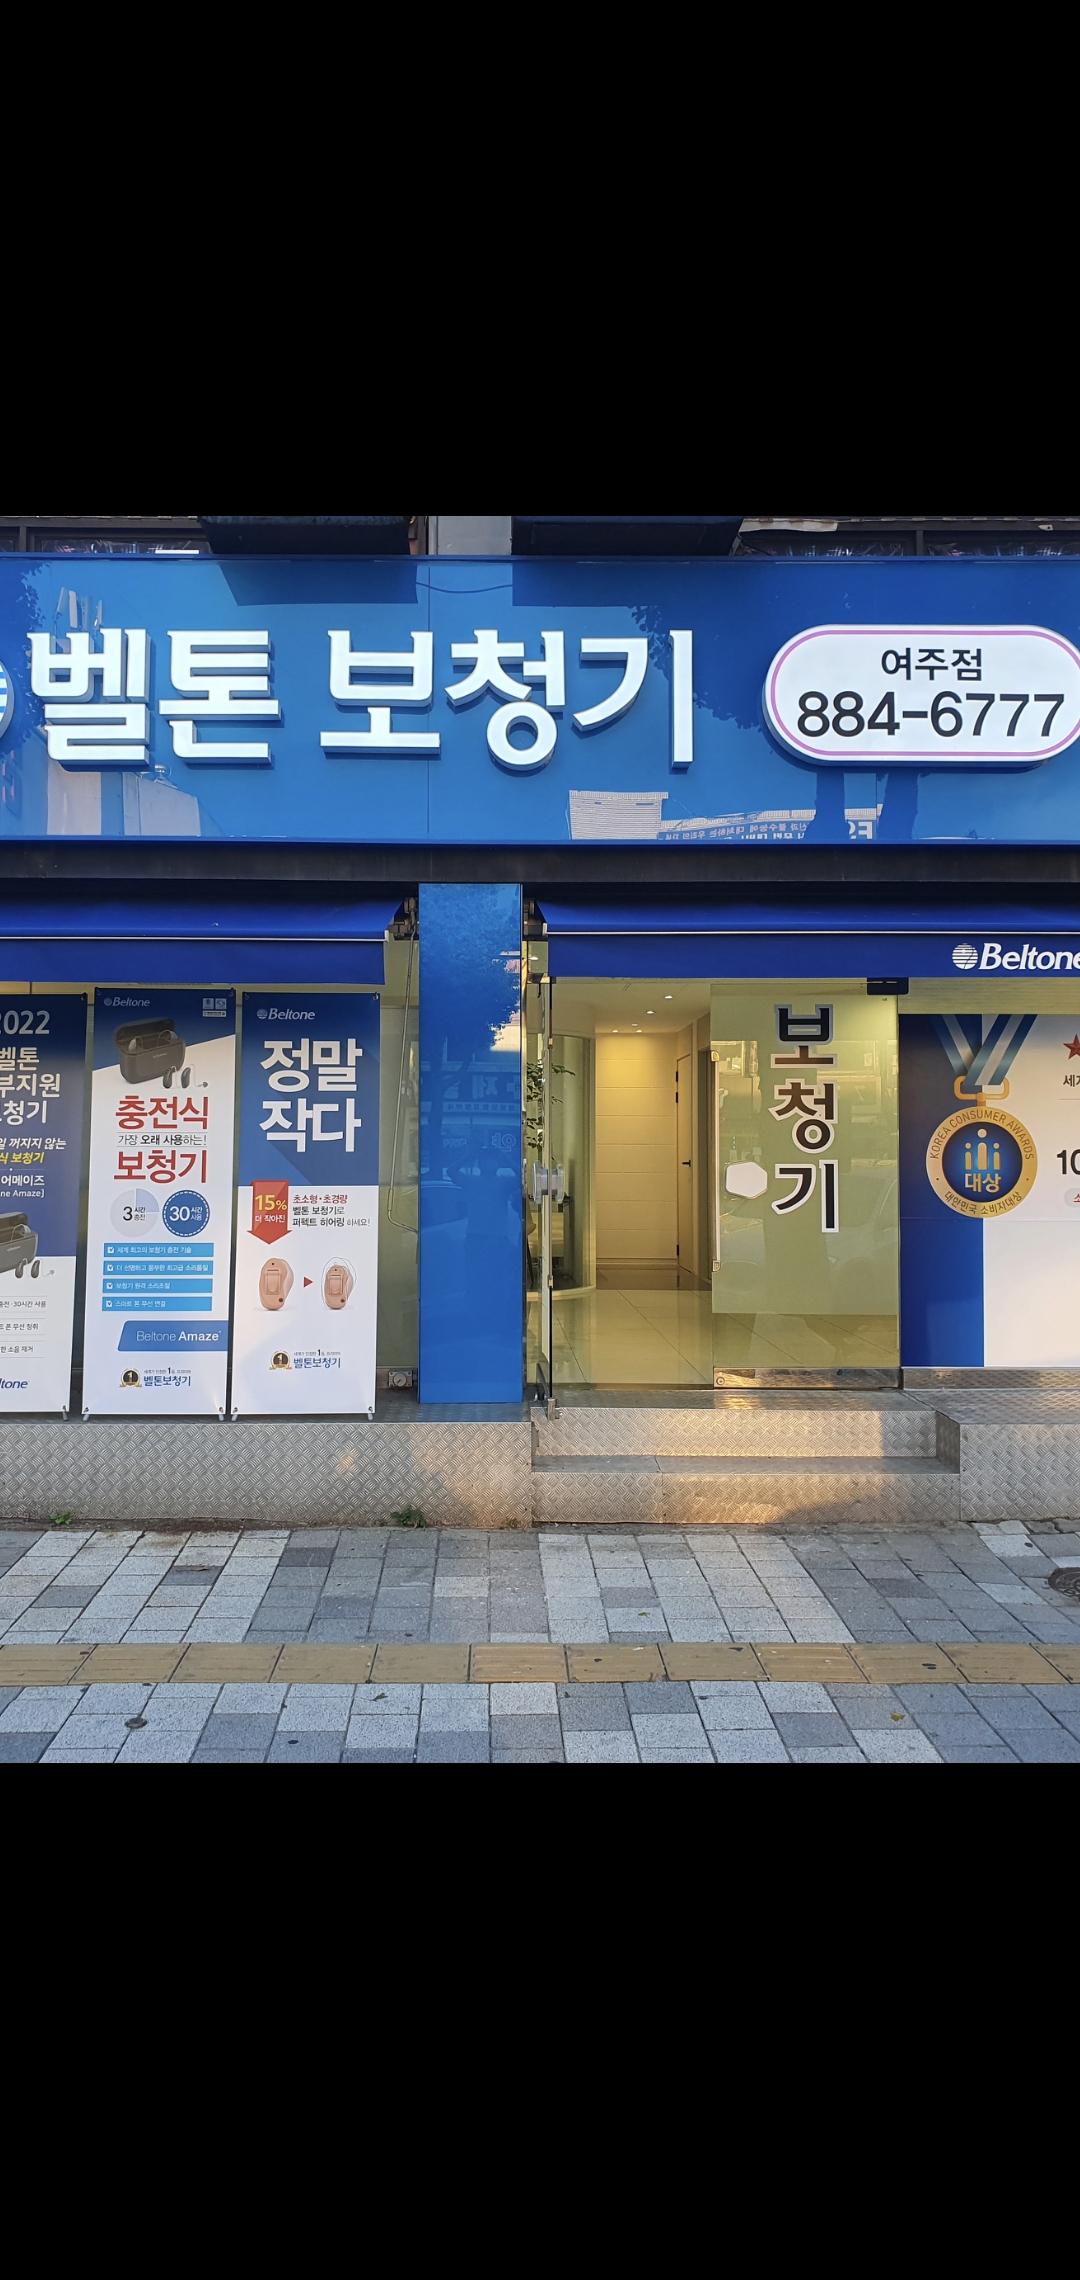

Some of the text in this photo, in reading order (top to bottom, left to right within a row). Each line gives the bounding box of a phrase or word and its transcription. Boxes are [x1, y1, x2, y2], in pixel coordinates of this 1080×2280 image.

[881, 648, 982, 681] 여주점
[27, 628, 693, 772] 벨톤 보청기
[797, 691, 1065, 738] 884-6777
[113, 997, 150, 1007] Beltone
[0, 1010, 50, 1034] 022
[268, 1008, 315, 1020] Beltone
[260, 1038, 363, 1092] 정말
[0, 1100, 47, 1125] 청기
[116, 1095, 208, 1130] 충전식
[769, 1004, 839, 1233] 보청기
[259, 1098, 362, 1152] 작다
[9, 1137, 42, 1149] 꺼지지
[44, 1137, 66, 1150] 않는
[118, 1134, 207, 1145] 가장 오래 사용하는!
[930, 1110, 1034, 1160] KOREA CONSUMER AWARDS
[11, 1152, 44, 1164] 보청기
[114, 1150, 207, 1184] 보청기
[1, 1174, 44, 1186] 어메이즈
[965, 1173, 1001, 1193] 대상
[255, 1194, 287, 1211] 15%
[293, 1206, 345, 1215] 벨톤 보청기로
[981, 1192, 1022, 1214] 소비자대상
[123, 1206, 133, 1221] 3
[169, 1206, 191, 1221] 30
[264, 1214, 285, 1223] 작아진
[293, 1218, 370, 1227] 퍼펙트 히어링 하세요!
[136, 1331, 176, 1341] Beltone
